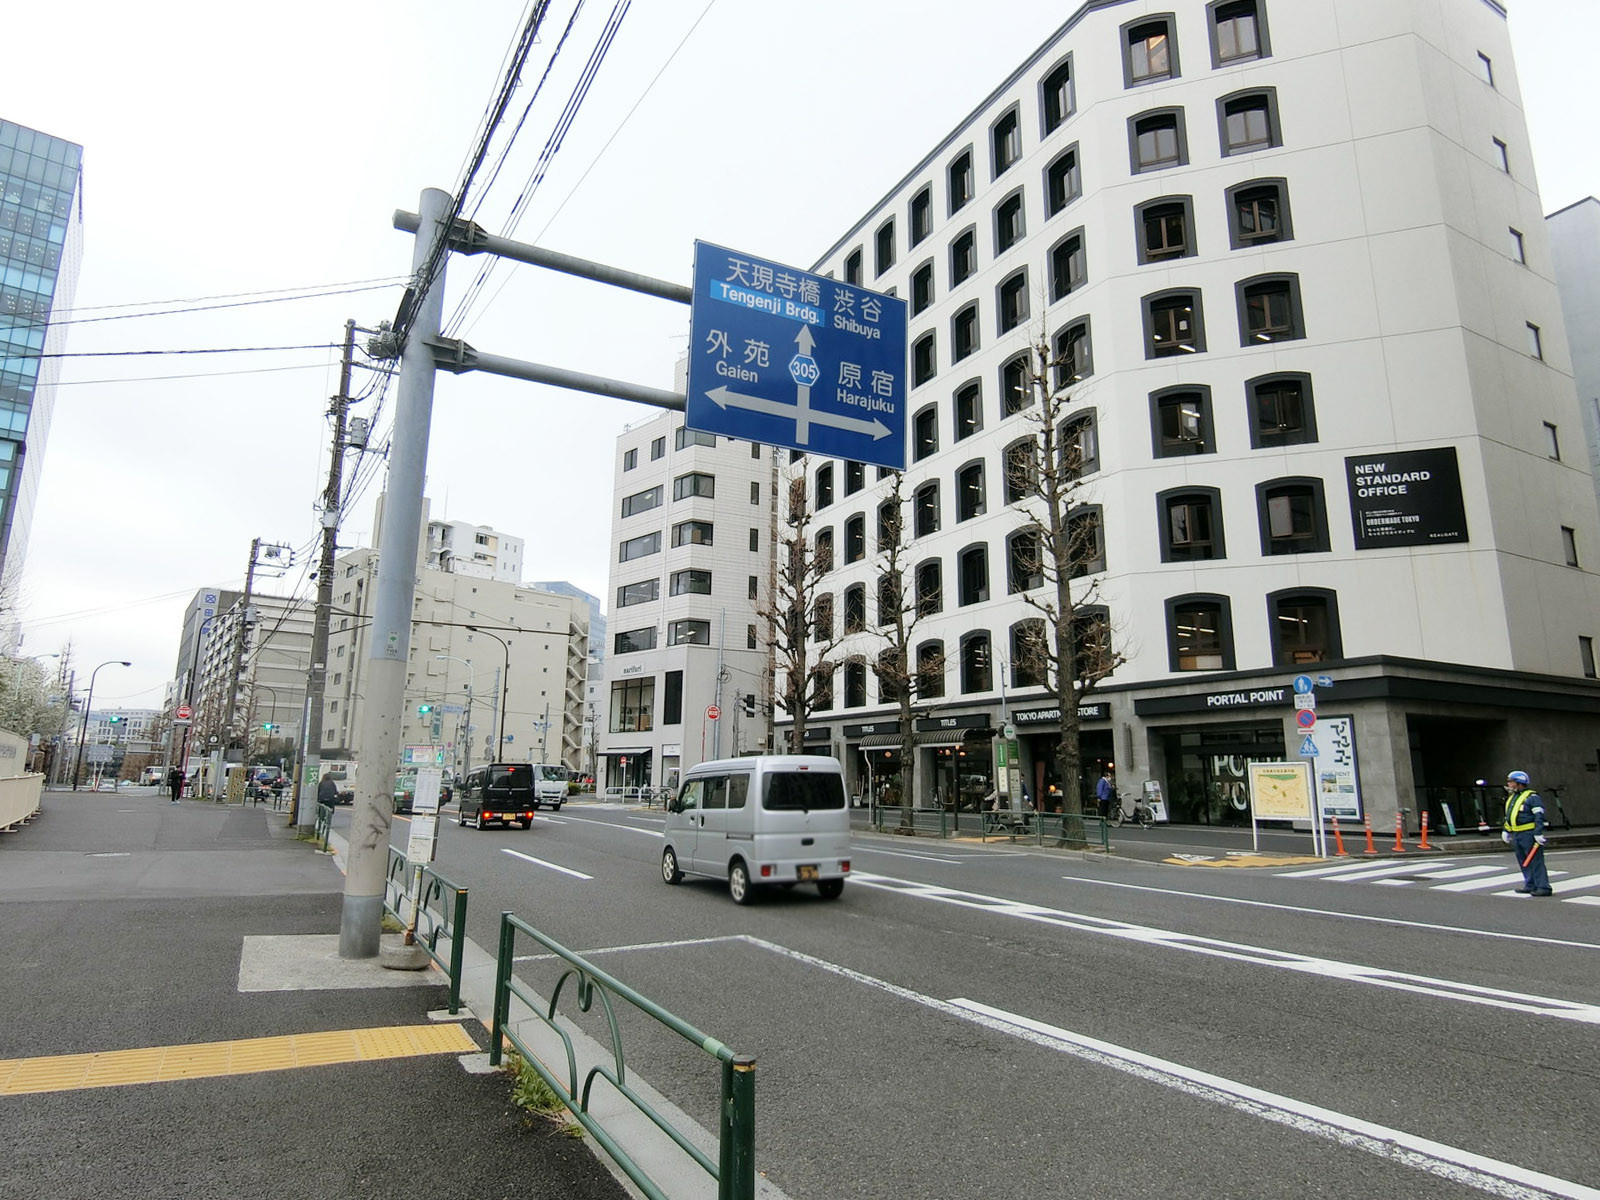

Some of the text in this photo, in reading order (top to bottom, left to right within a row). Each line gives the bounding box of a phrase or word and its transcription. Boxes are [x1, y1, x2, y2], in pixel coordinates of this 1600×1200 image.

[726, 257, 821, 307] 天現寺橋
[720, 283, 820, 324] Tengenji Brdg.
[832, 287, 883, 323] 渋谷
[833, 315, 881, 340] Shibuya
[705, 329, 770, 368] 外苑
[715, 360, 759, 384] Gaien
[793, 361, 817, 380] 305
[838, 361, 895, 398] 原宿
[836, 389, 895, 414] Harajuku
[1354, 463, 1386, 475] NEW
[1356, 471, 1431, 486] STANDARD
[1357, 484, 1408, 498] OFFICE
[1401, 515, 1420, 523] TOKYO
[1207, 693, 1248, 706] PORTAL
[1250, 689, 1284, 703] POINT
[1016, 712, 1037, 721] TOKYO
